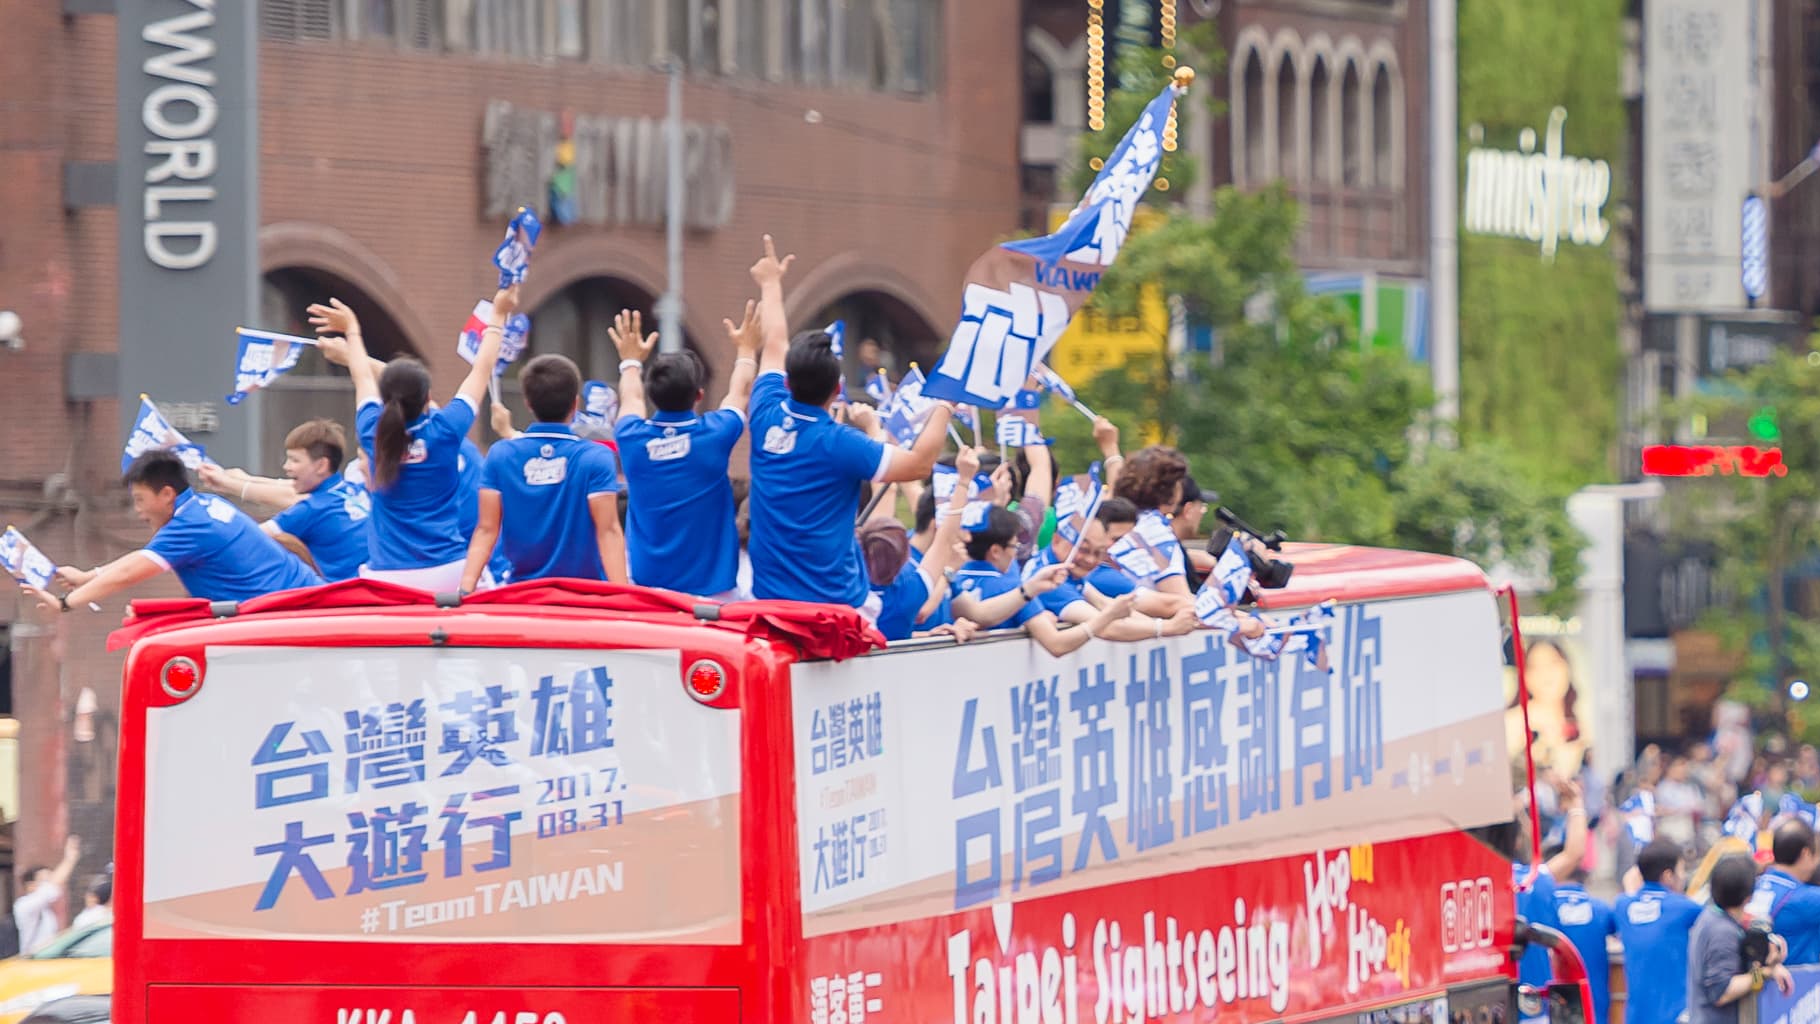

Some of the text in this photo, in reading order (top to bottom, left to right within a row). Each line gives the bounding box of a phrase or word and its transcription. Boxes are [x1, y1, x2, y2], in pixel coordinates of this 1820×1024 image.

[142, 0, 217, 270] WORLD
[251, 666, 614, 809] 台灣英雄
[810, 690, 884, 776] 台灣英雄
[953, 600, 1385, 910] 台灣英雄感謝有你
[253, 784, 522, 912] 大遊行
[536, 800, 624, 839] 08.31
[812, 813, 867, 895] 大遊行
[360, 861, 624, 933] #TeamTAIWAN
[1349, 901, 1387, 994] Hop
